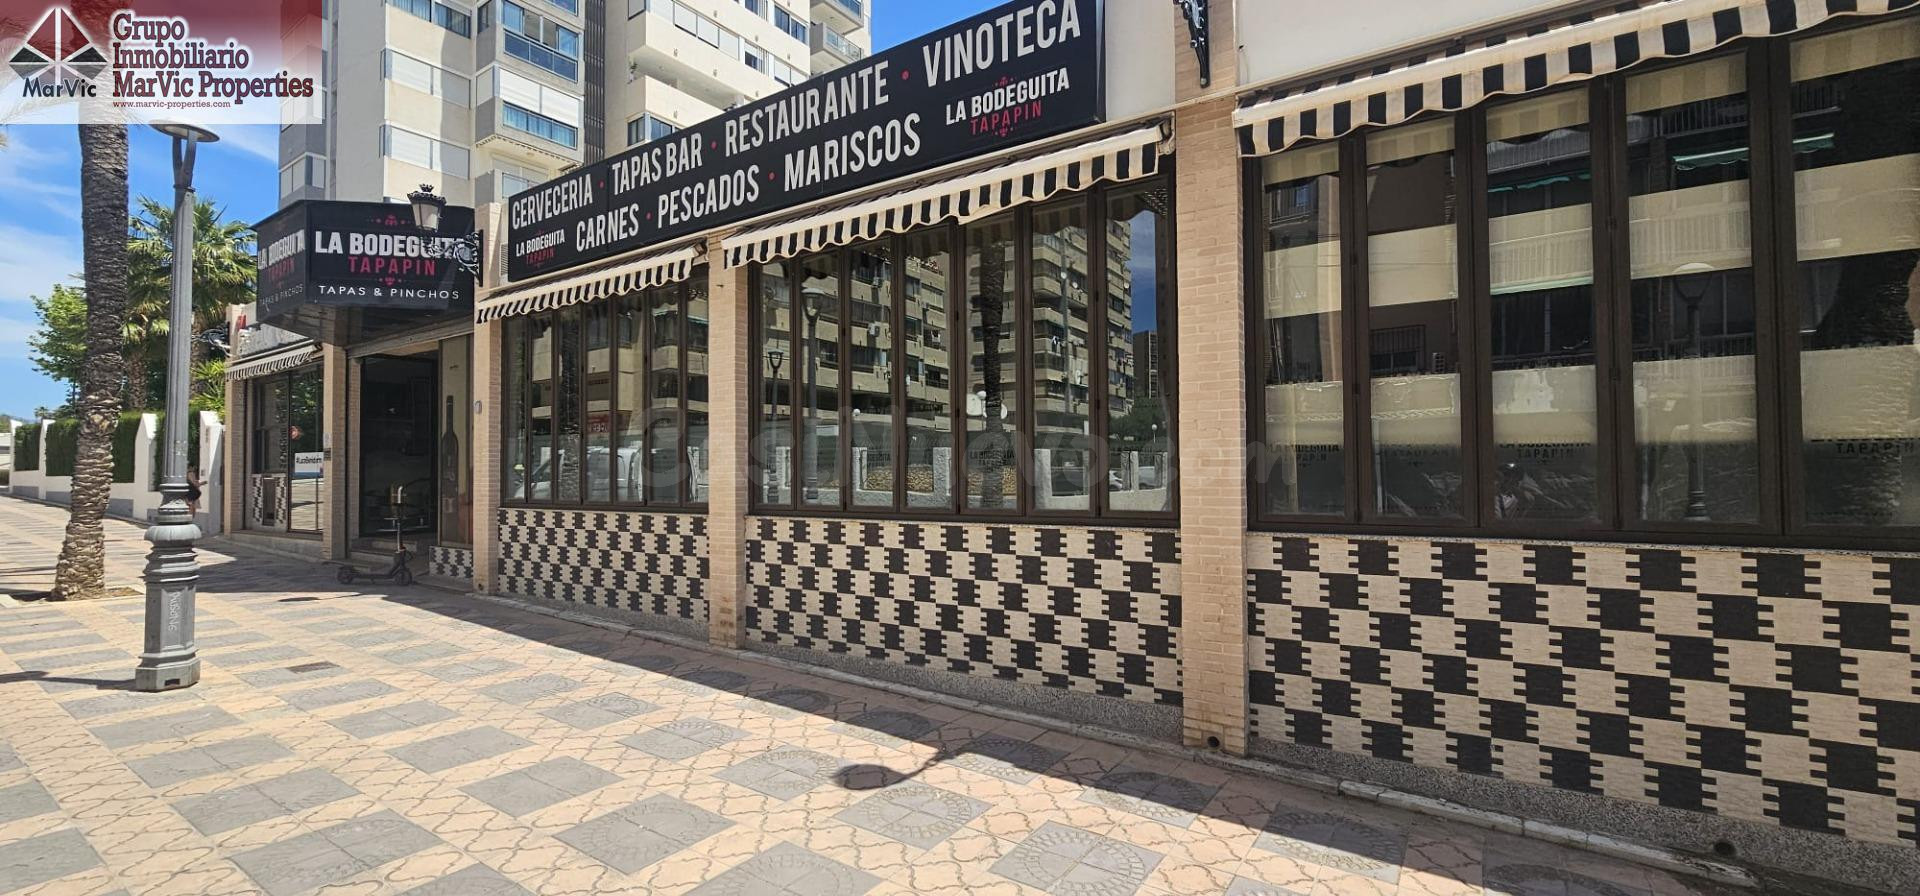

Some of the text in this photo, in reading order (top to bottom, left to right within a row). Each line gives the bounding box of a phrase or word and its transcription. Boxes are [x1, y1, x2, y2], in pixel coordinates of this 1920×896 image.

[945, 67, 1070, 126] LA BODEGUITA
[512, 0, 1081, 230] CERVECERIA TAPAS BAR RESTAURANTE VINOTECA
[971, 101, 1043, 135] TAPAPIN
[576, 112, 921, 253] CARNES PESCADOS MARISCOS
[315, 231, 465, 259] LA BODEGUIT
[515, 229, 565, 257] LA BODEGUITA
[526, 248, 554, 265] TAPAPIN
[348, 256, 436, 276] TAPAPIN
[319, 285, 460, 300] TAPAS & PINCHOS
